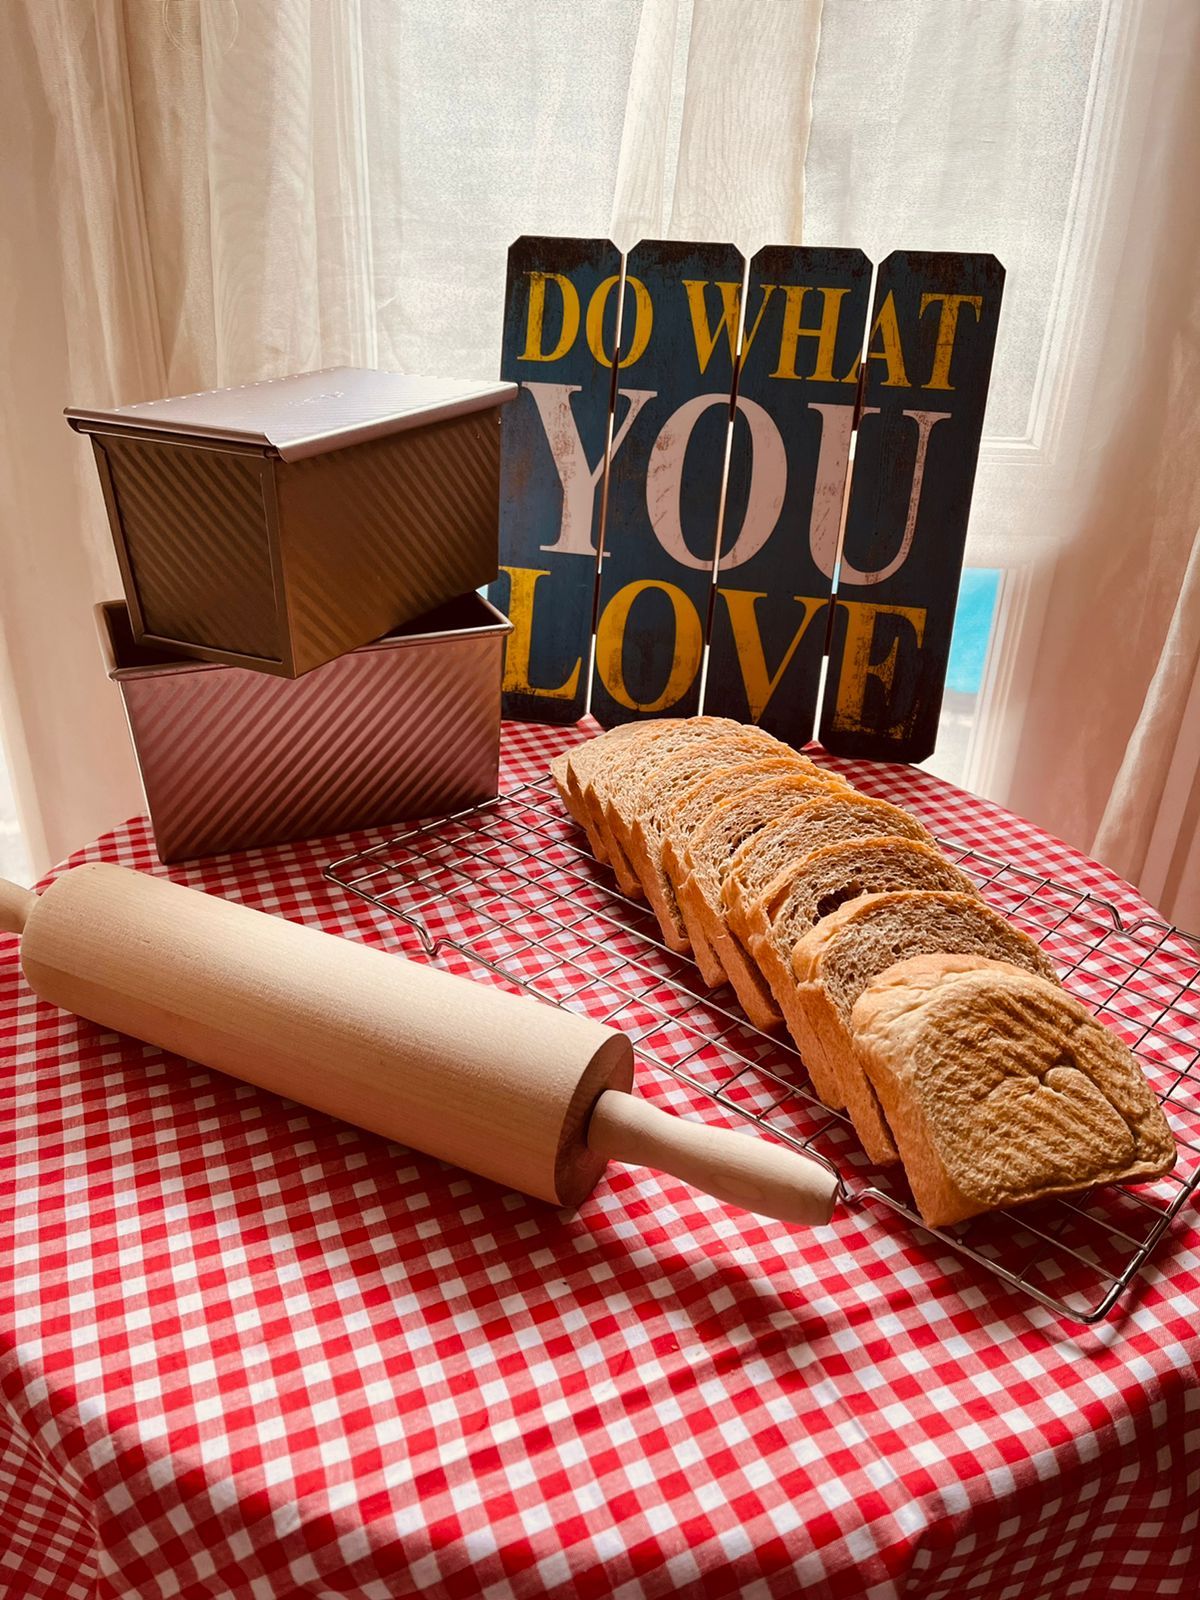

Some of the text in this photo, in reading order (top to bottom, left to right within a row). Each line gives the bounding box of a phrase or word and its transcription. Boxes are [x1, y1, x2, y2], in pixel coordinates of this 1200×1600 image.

[517, 271, 983, 391] DO WHAT
[521, 381, 953, 587] YOU
[499, 565, 928, 741] LOVE
